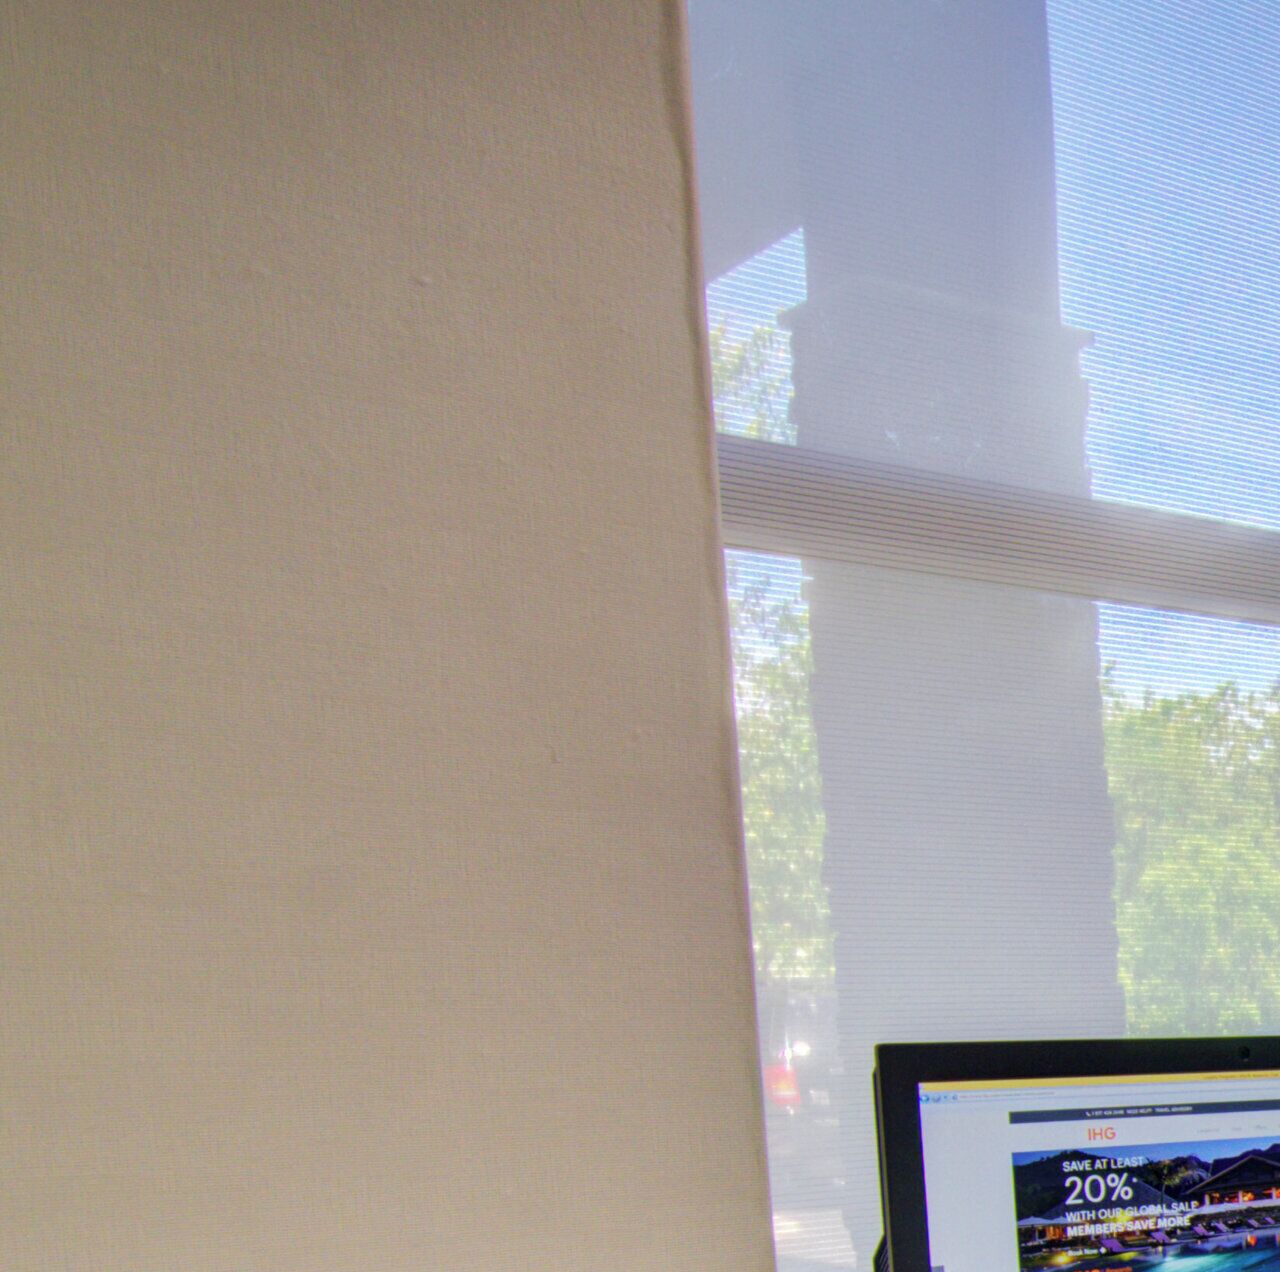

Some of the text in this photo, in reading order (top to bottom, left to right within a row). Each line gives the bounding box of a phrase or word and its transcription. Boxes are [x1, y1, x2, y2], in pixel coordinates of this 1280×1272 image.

[1088, 1127, 1116, 1140] IHG
[1062, 1157, 1144, 1172] SAVE AT LEAST
[1066, 1201, 1198, 1222] WITH OUR GLOBAL SALE
[1066, 1216, 1191, 1237] MEMBERS SAVE MORE
